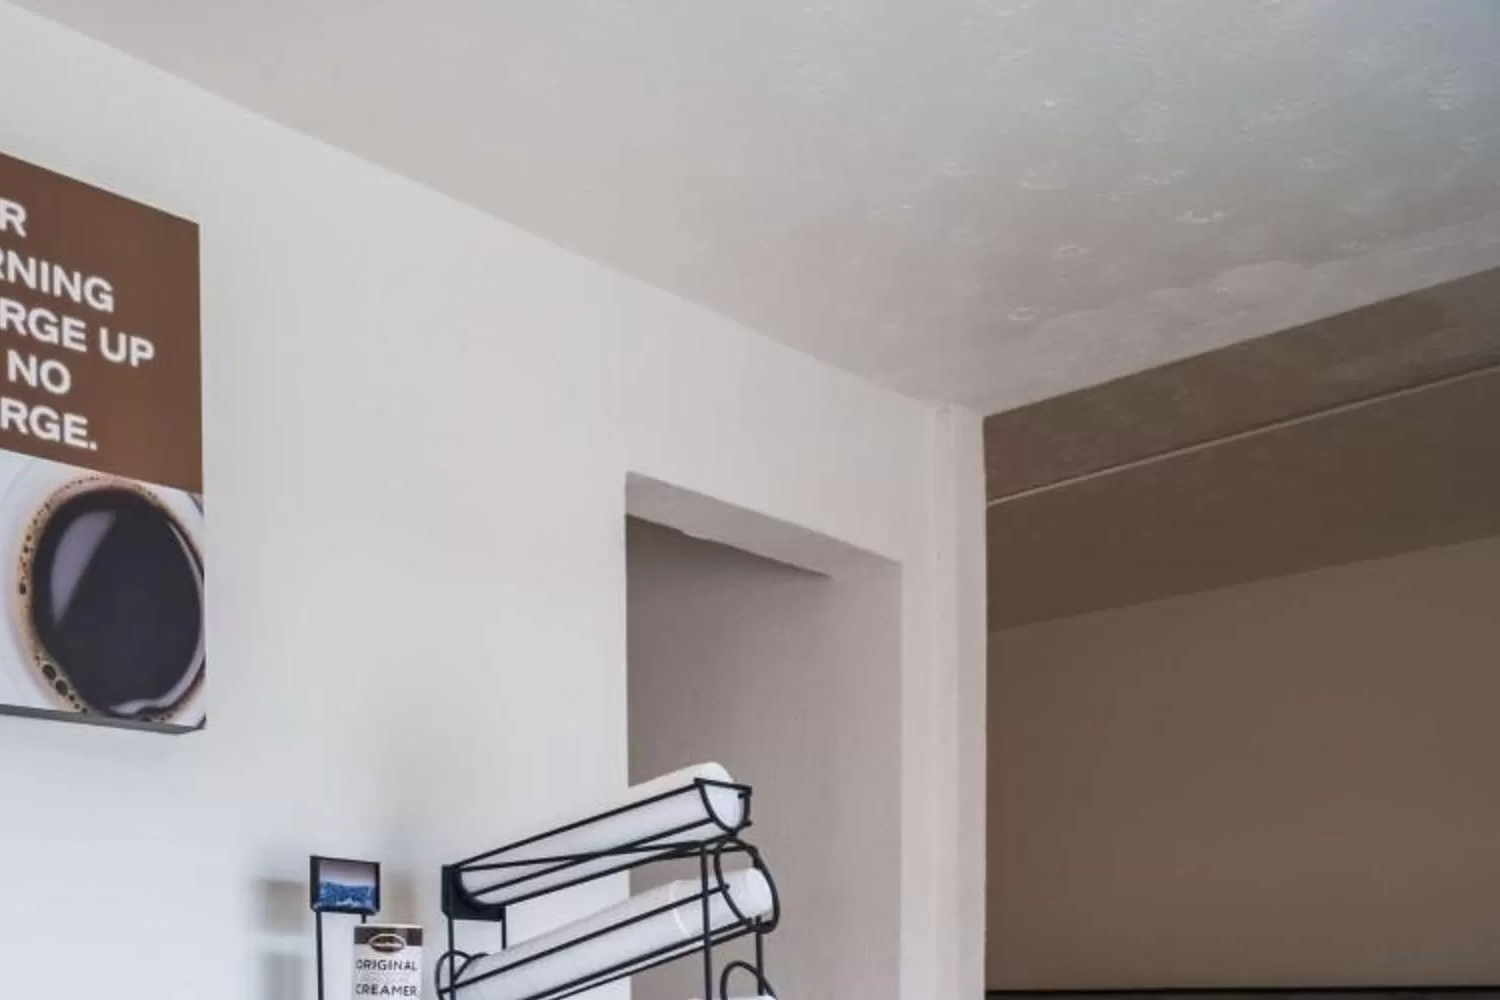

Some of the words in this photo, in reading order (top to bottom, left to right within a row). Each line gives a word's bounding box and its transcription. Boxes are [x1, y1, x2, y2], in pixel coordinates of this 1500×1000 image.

[99, 327, 155, 368] UP
[6, 349, 72, 395] NO
[355, 959, 419, 972] ORIGINAL
[355, 983, 418, 997] CREAMER
